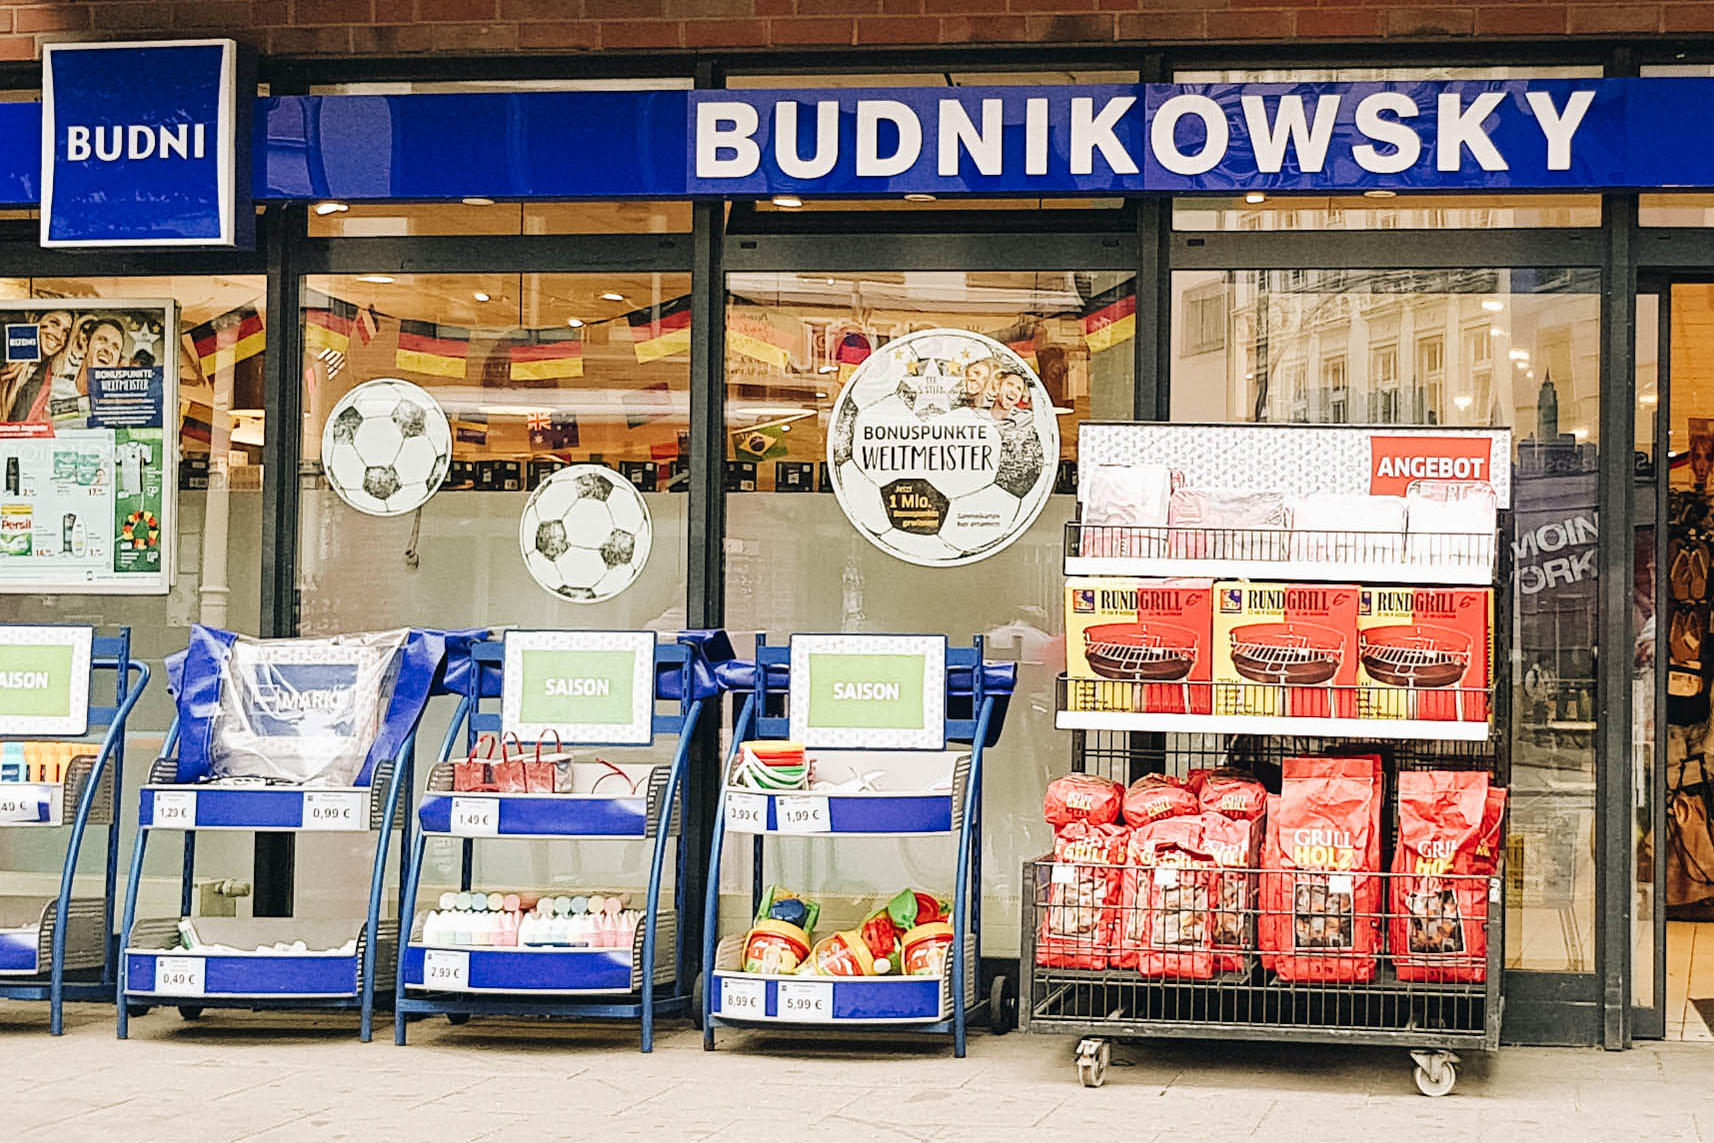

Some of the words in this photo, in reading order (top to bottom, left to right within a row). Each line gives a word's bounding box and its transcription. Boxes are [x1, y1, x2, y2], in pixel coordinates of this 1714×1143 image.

[696, 90, 1596, 179] BUDNIKOWSKY
[67, 123, 205, 162] BUDNI
[864, 425, 987, 441] BONUSPUNKTE
[862, 444, 994, 471] WELTMEISTER
[1376, 456, 1485, 479] ANGEBOT
[889, 494, 897, 508] 1
[2, 519, 31, 530] Persil
[1513, 549, 1599, 594] ORK
[0, 671, 48, 689] AISON
[545, 678, 609, 697] SAISON
[833, 682, 900, 700] SAISON
[161, 807, 179, 818] 1,29
[181, 807, 188, 818] €
[313, 807, 339, 820] 0,99
[343, 807, 351, 819] €
[460, 814, 480, 826] 1,49
[482, 814, 489, 826] €
[753, 810, 760, 821] €
[786, 810, 809, 823] 1,99
[812, 809, 821, 820] €
[1294, 828, 1354, 849] GRILL
[1294, 846, 1353, 869] HOLZ
[163, 973, 185, 985] 0,49
[188, 973, 196, 985] €
[431, 966, 451, 979] 2,99
[453, 967, 461, 979] €
[727, 994, 748, 1008] 8,99
[750, 996, 757, 1008] €
[786, 998, 812, 1011] 5,99
[815, 999, 823, 1010] €
